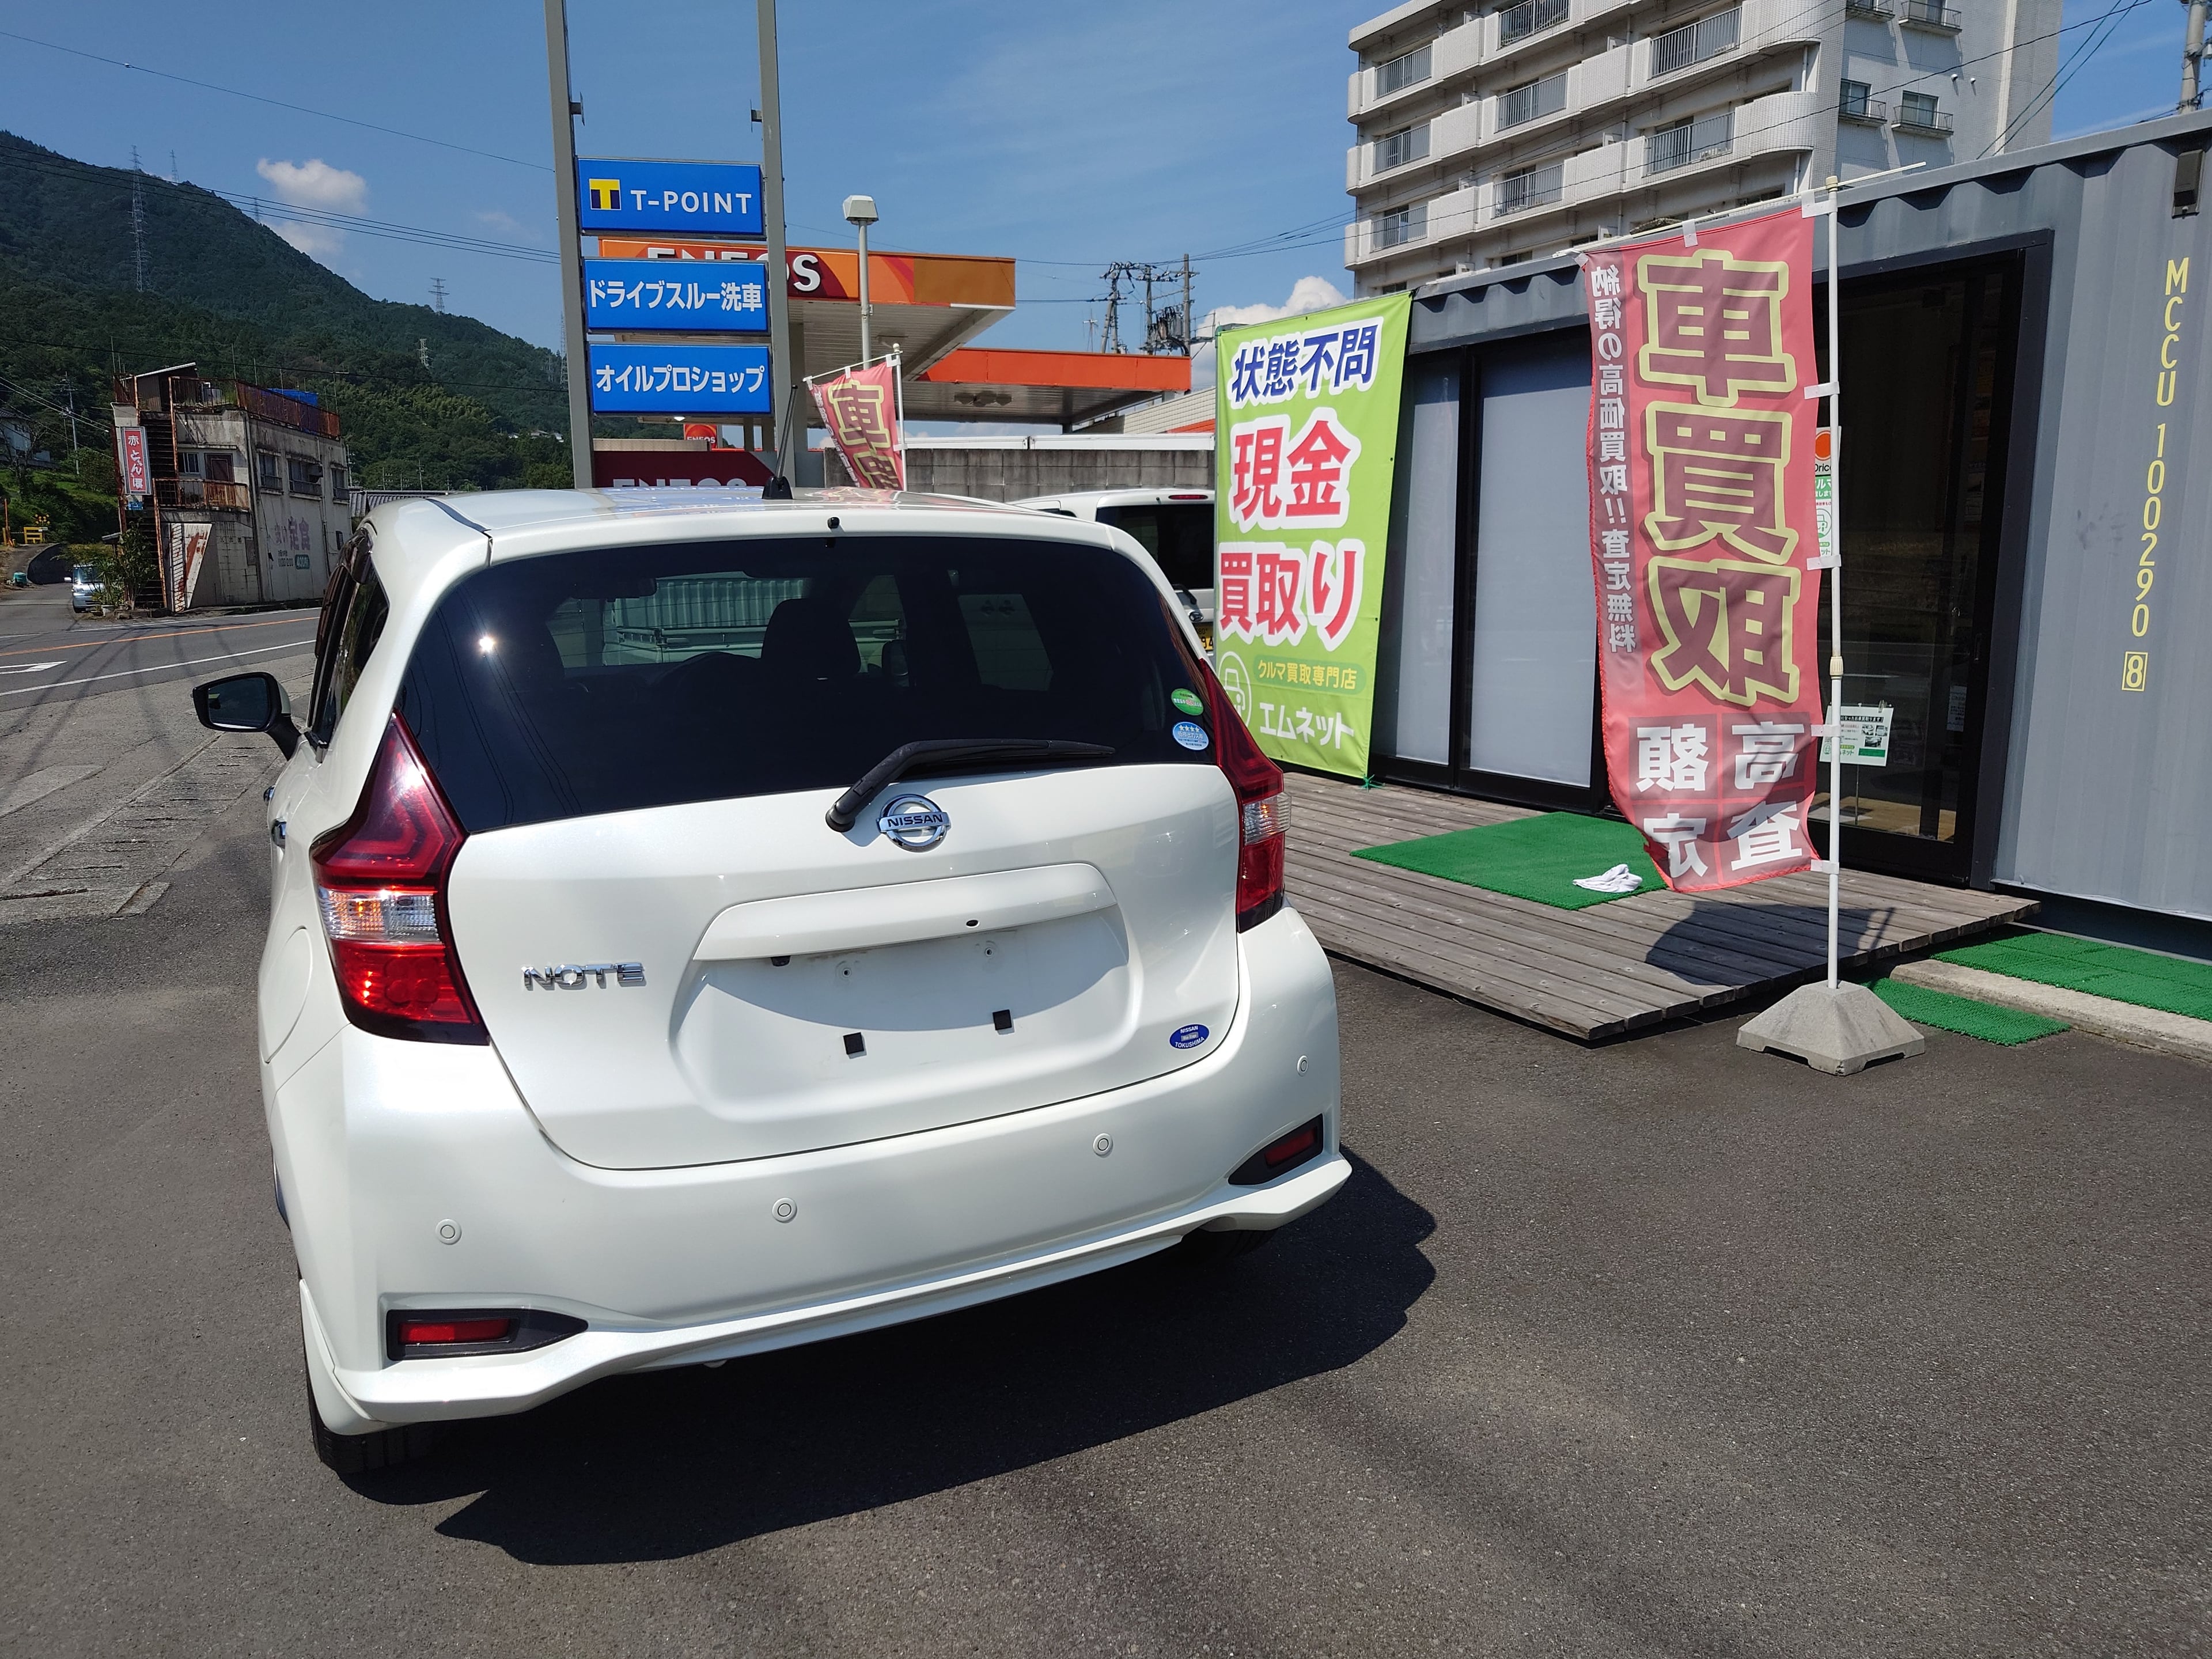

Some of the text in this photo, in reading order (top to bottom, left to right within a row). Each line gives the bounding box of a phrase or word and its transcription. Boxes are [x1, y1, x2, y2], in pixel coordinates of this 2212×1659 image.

[630, 190, 752, 214] T-POINT
[589, 279, 763, 312] ドライブスルー洗車
[2156, 257, 2189, 407] MCCU
[596, 364, 765, 393] オイルプロショップ
[1231, 324, 1379, 403] 状態不問
[1233, 419, 1352, 522] 現金
[1815, 463, 1831, 472] Oric
[2131, 423, 2166, 637] 100290
[1219, 550, 1358, 640] 買取り
[1257, 659, 1358, 690] クルマ買取専門店
[1259, 702, 1355, 750] エムネット
[887, 814, 943, 828] NISSAN
[521, 963, 645, 988] NOTE
[1175, 1037, 1205, 1048] TOKUSHIMA
[1180, 1025, 1198, 1033] NISSAN
